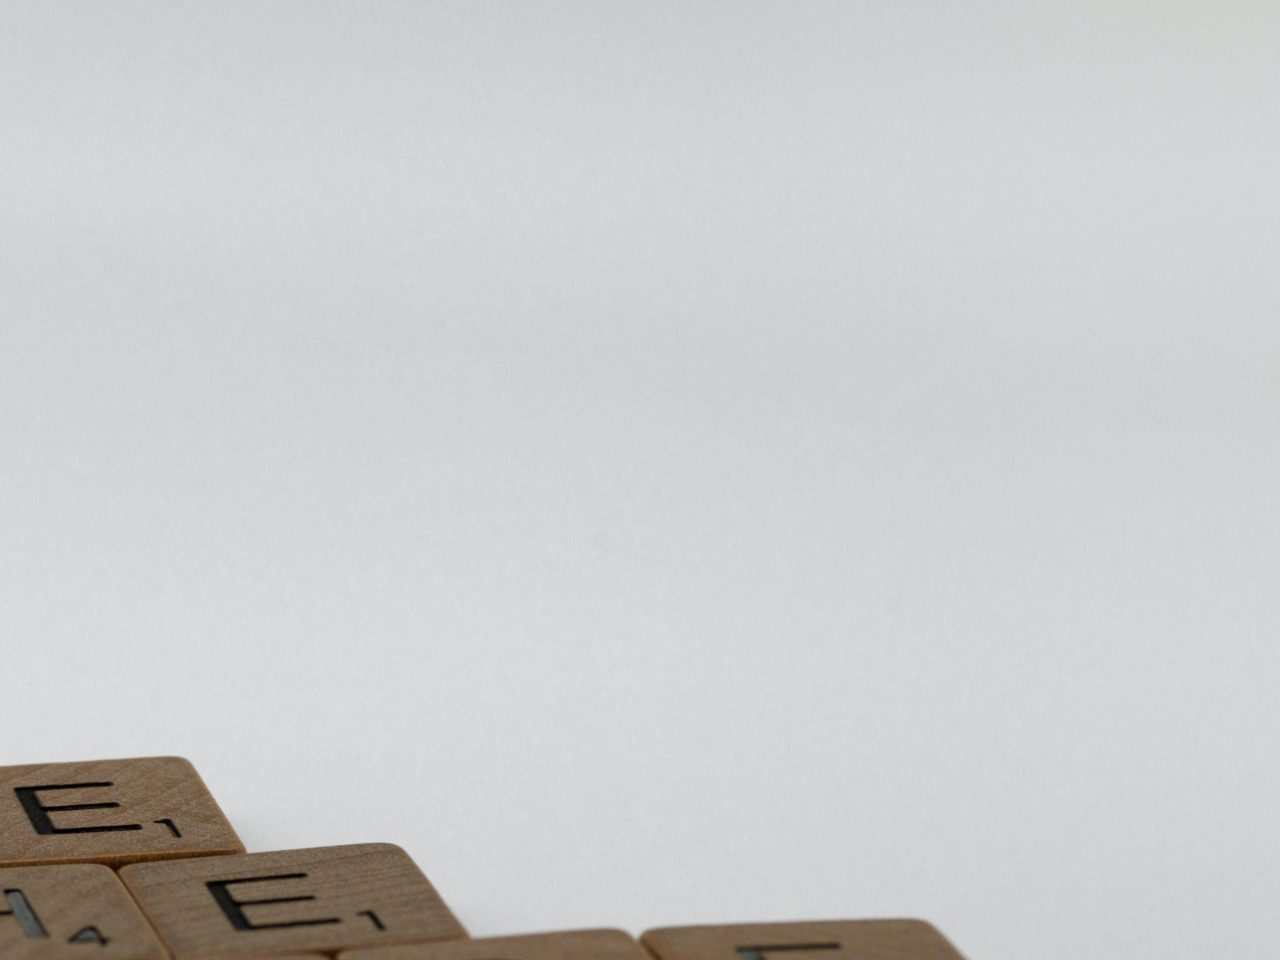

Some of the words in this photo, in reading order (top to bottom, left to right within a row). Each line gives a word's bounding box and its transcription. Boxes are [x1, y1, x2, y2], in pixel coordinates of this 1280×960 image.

[152, 817, 184, 839] 1
[355, 909, 387, 932] 1
[67, 924, 111, 948] 4
